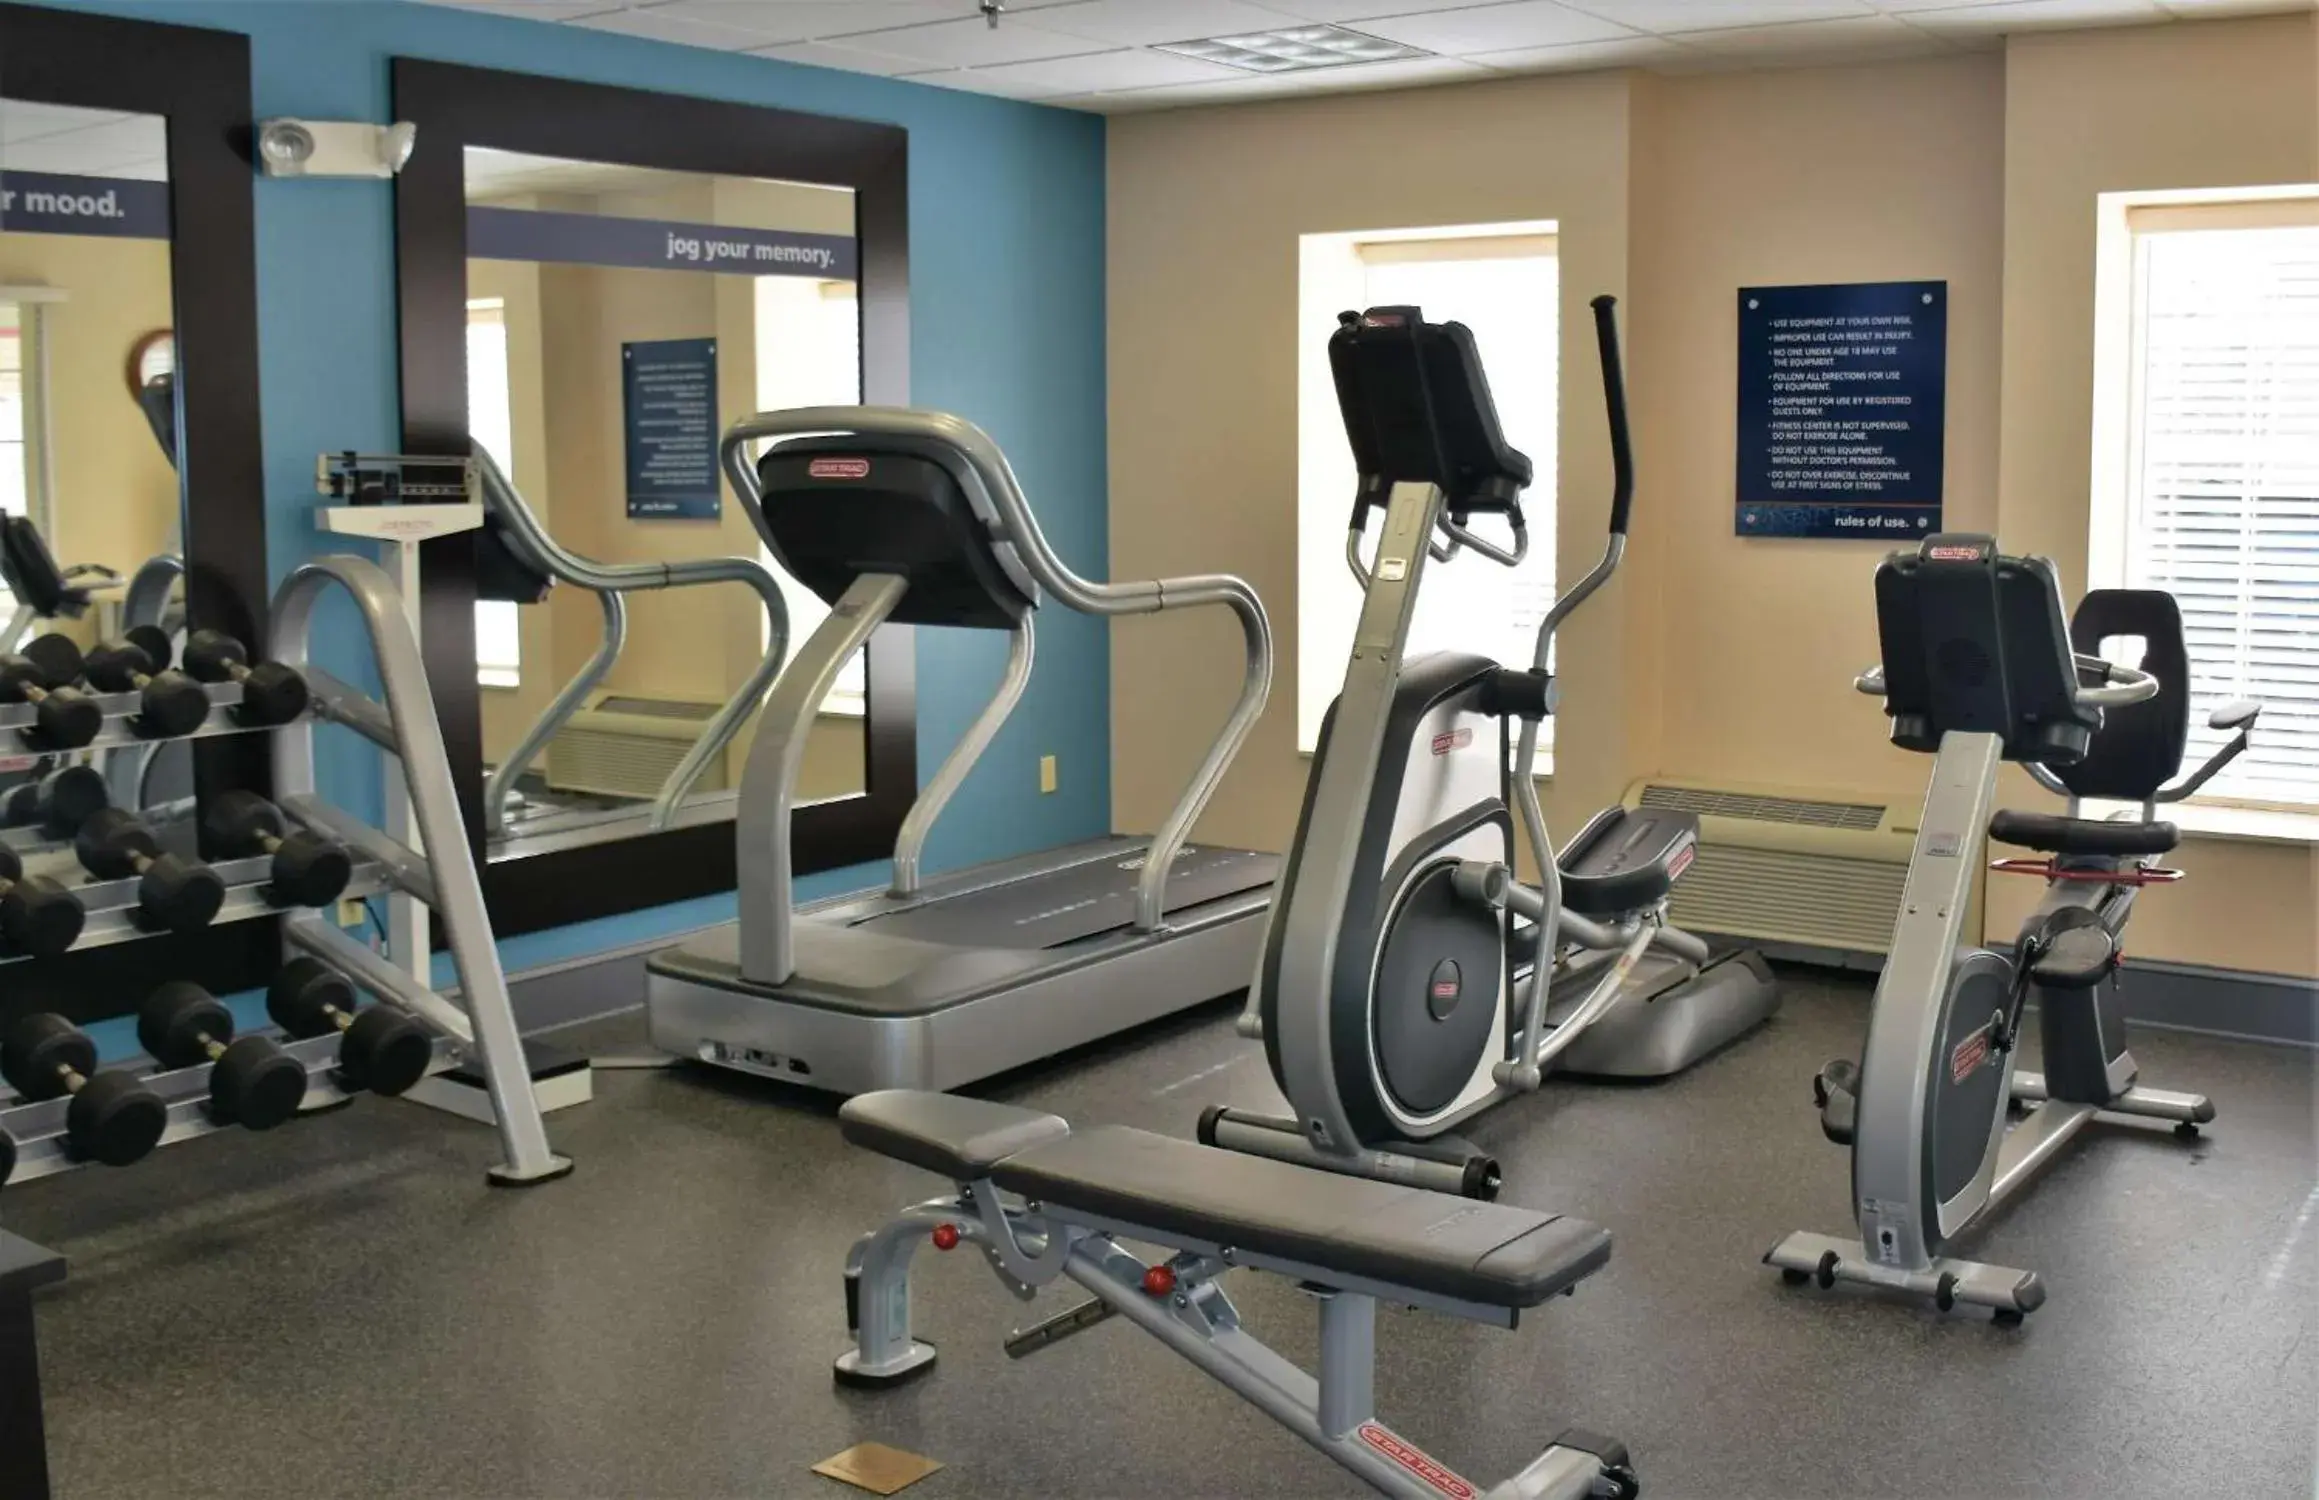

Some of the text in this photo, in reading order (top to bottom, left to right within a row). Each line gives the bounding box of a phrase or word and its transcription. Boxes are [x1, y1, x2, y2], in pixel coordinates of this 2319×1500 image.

[25, 189, 125, 217] mood.
[666, 232, 835, 269] jog your memory.
[1835, 516, 1910, 528] rules of use.
